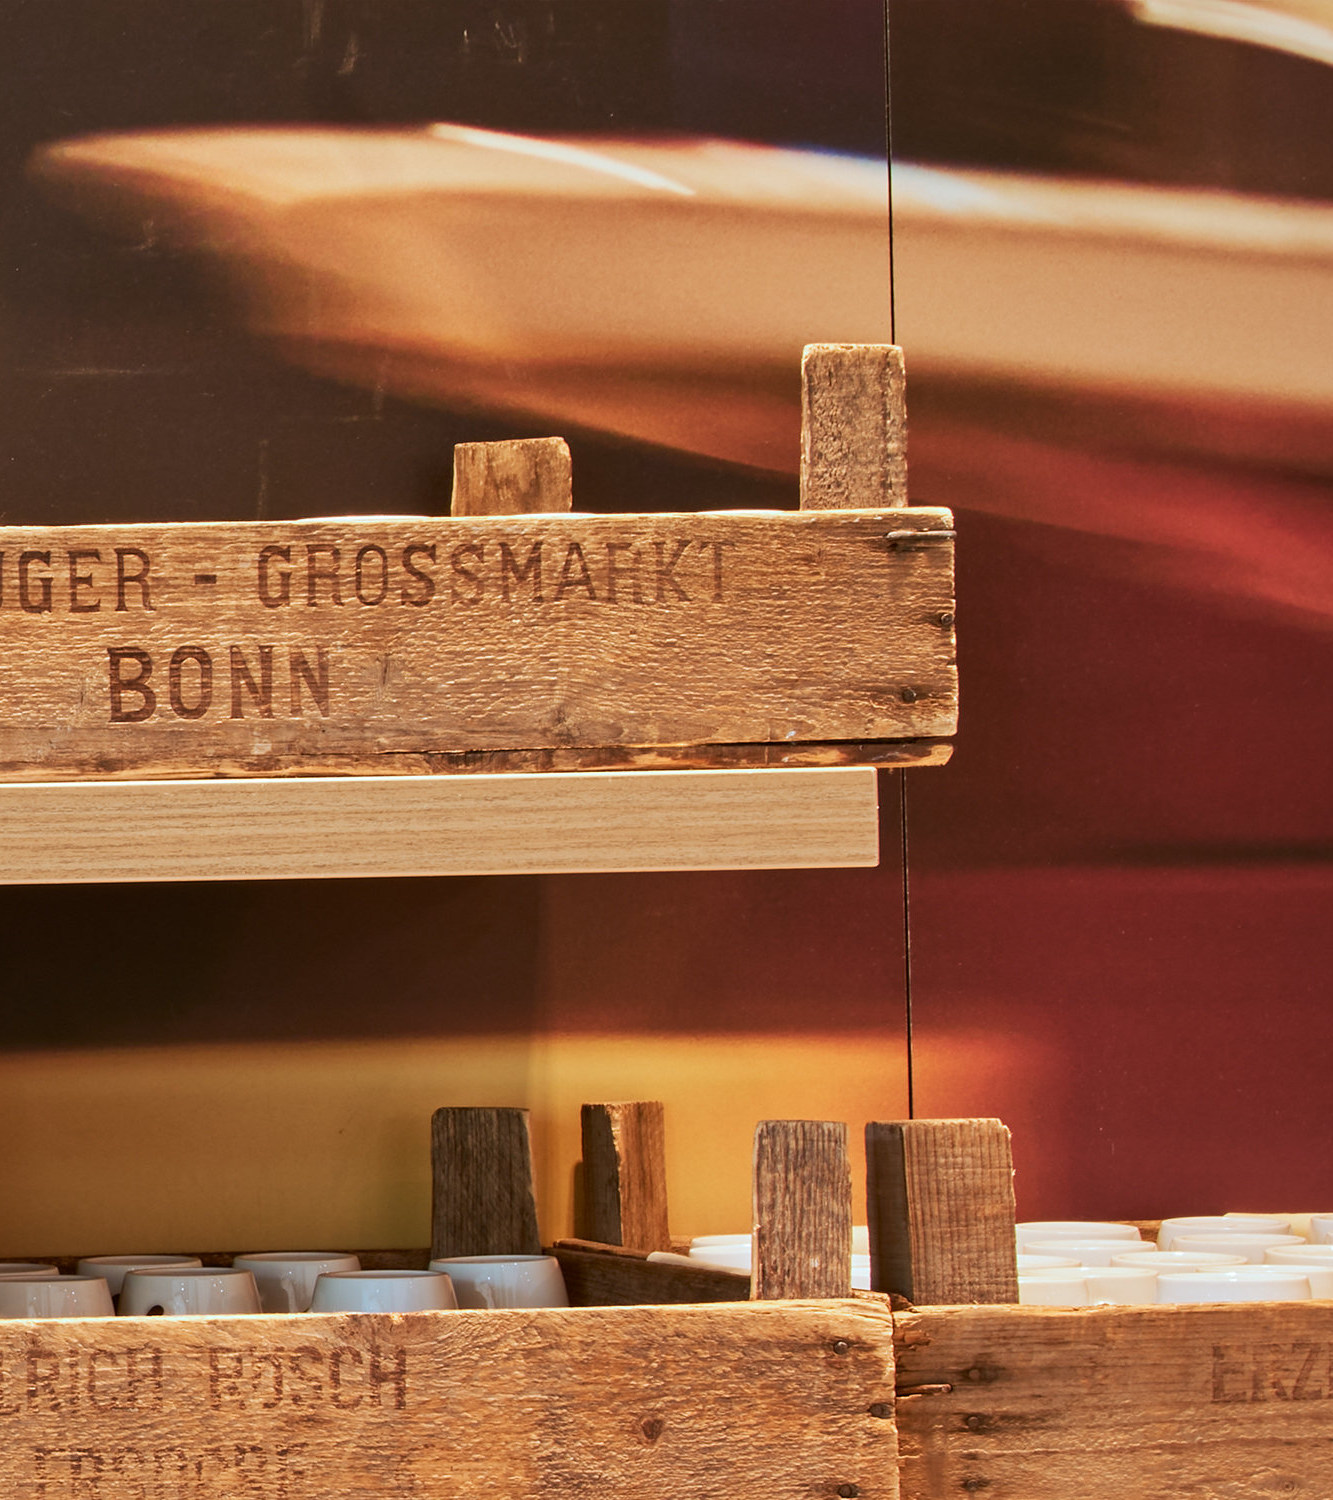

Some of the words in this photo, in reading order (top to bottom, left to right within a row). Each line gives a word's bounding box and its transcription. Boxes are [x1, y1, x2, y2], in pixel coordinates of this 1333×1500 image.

[256, 541, 734, 608] GROSSMARKT
[106, 645, 331, 724] BONN
[1211, 1341, 1333, 1405] ERZ
